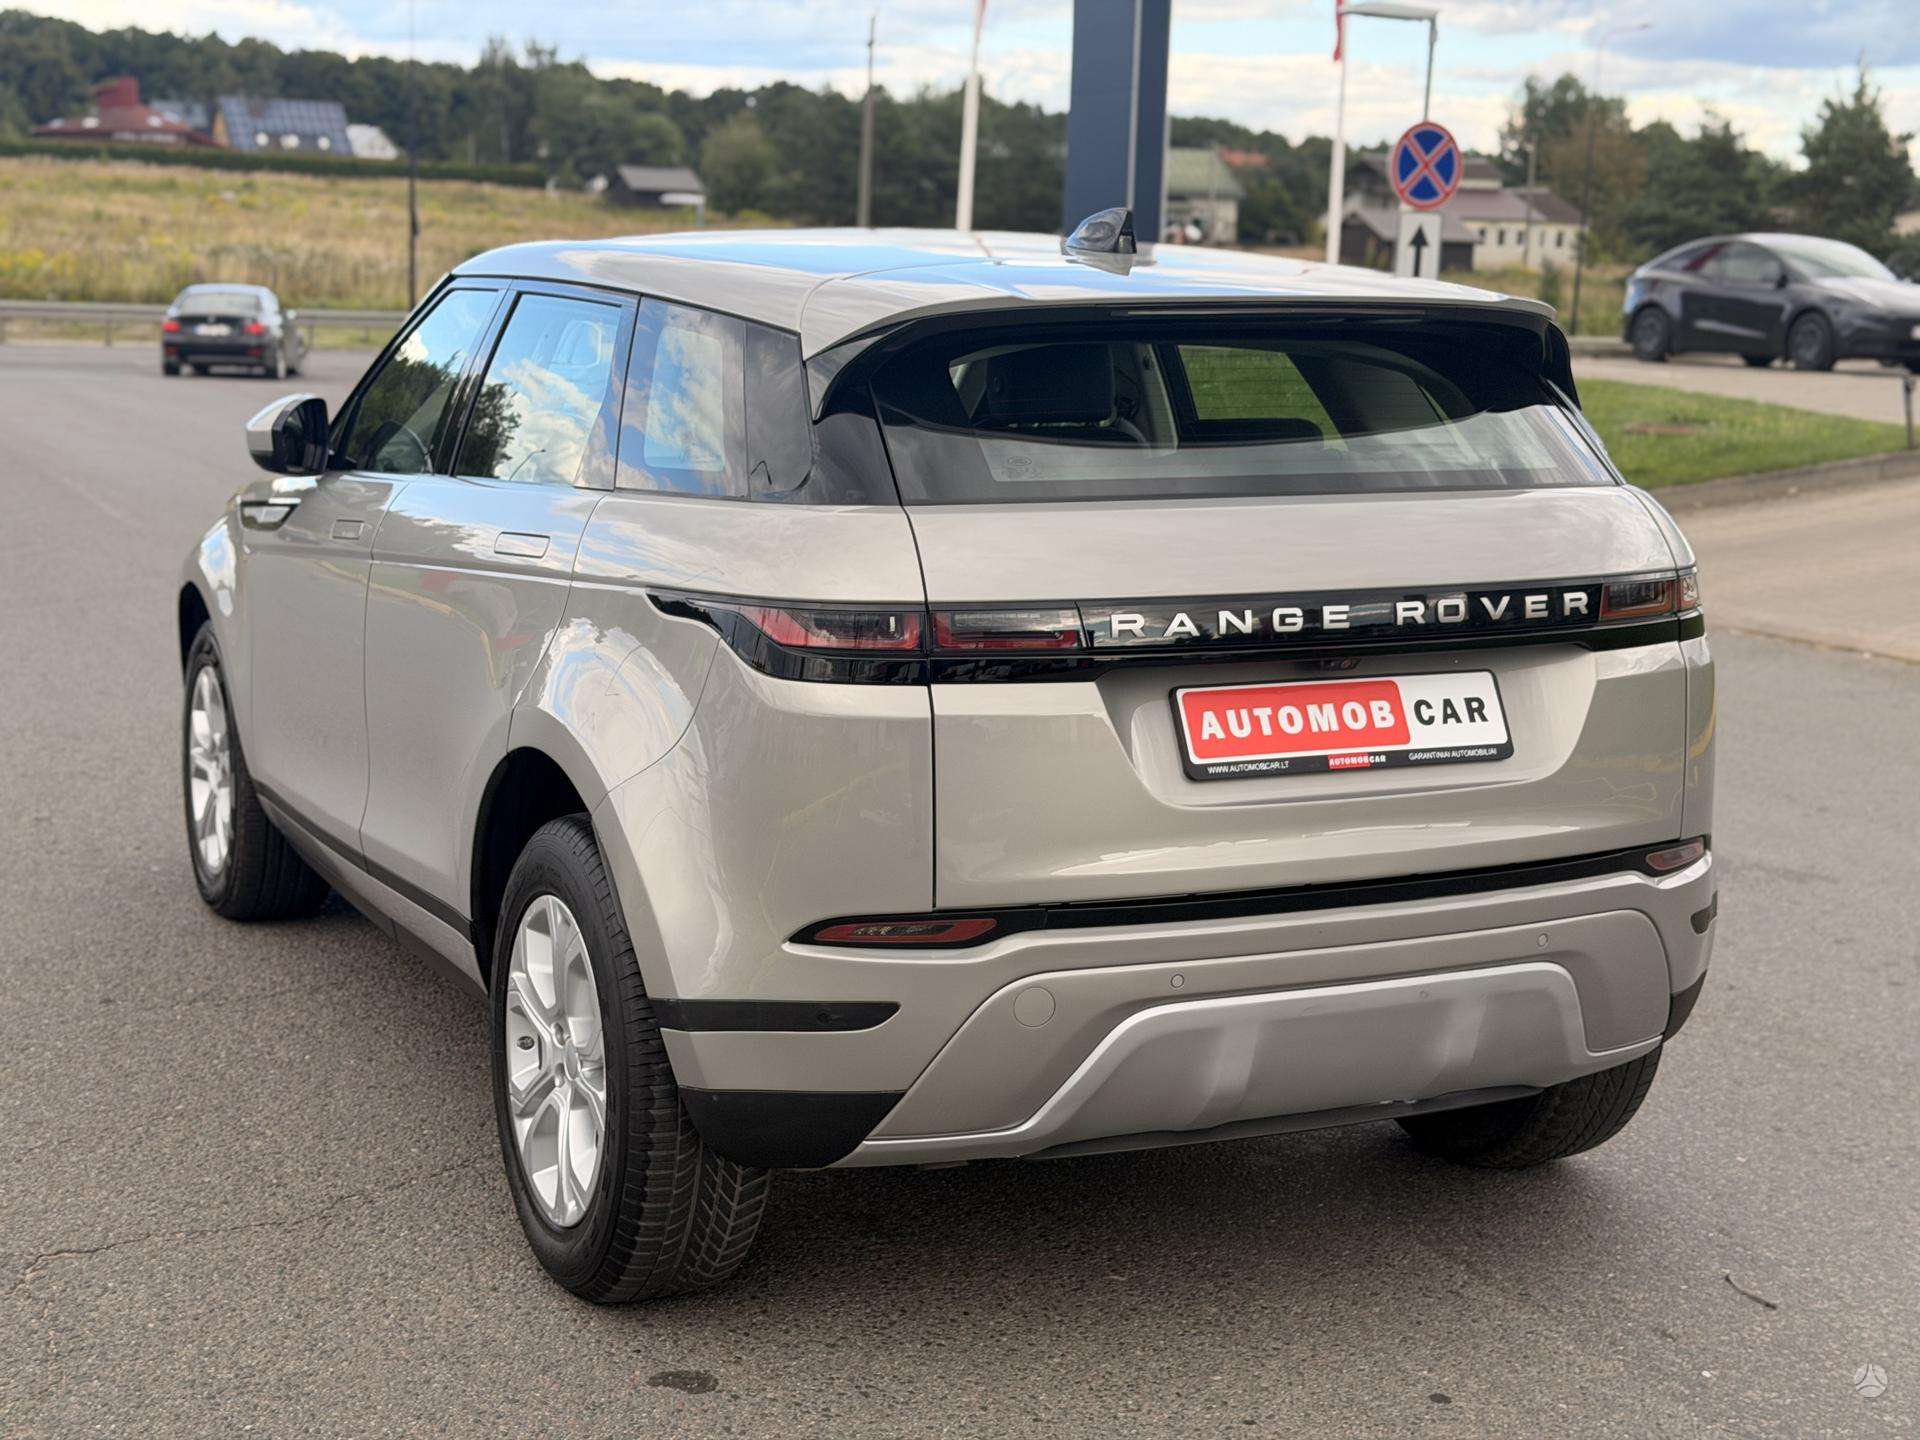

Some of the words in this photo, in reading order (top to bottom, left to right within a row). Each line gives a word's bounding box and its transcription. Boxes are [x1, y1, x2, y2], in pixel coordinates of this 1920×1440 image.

[1110, 605, 1350, 638] RANGE
[1396, 591, 1589, 626] ROVER
[1201, 699, 1396, 741] AUTOMOB
[1413, 696, 1490, 725] CAR
